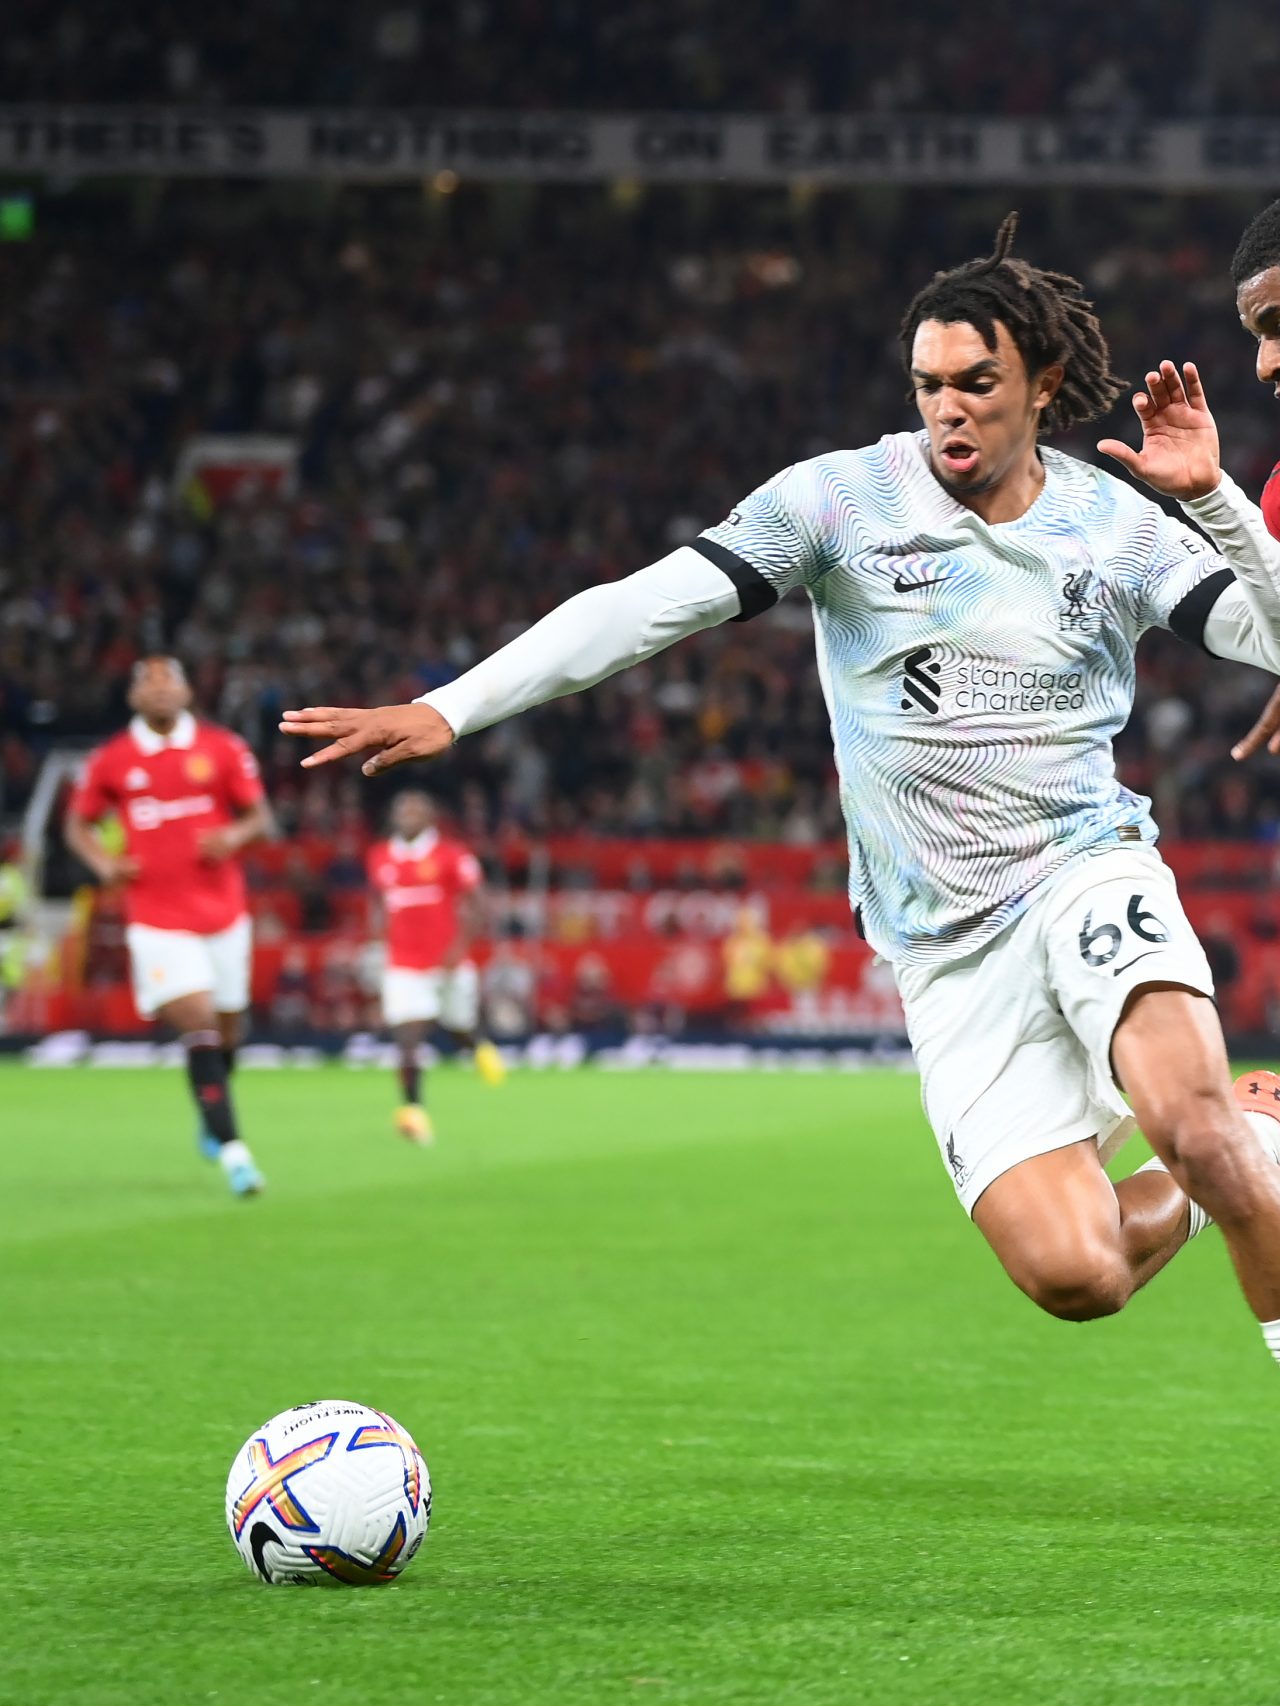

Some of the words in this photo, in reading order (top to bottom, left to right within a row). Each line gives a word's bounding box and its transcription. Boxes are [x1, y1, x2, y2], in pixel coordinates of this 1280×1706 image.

[957, 664, 1083, 690] standard
[955, 688, 1086, 712] chartered
[1079, 894, 1171, 967] 66
